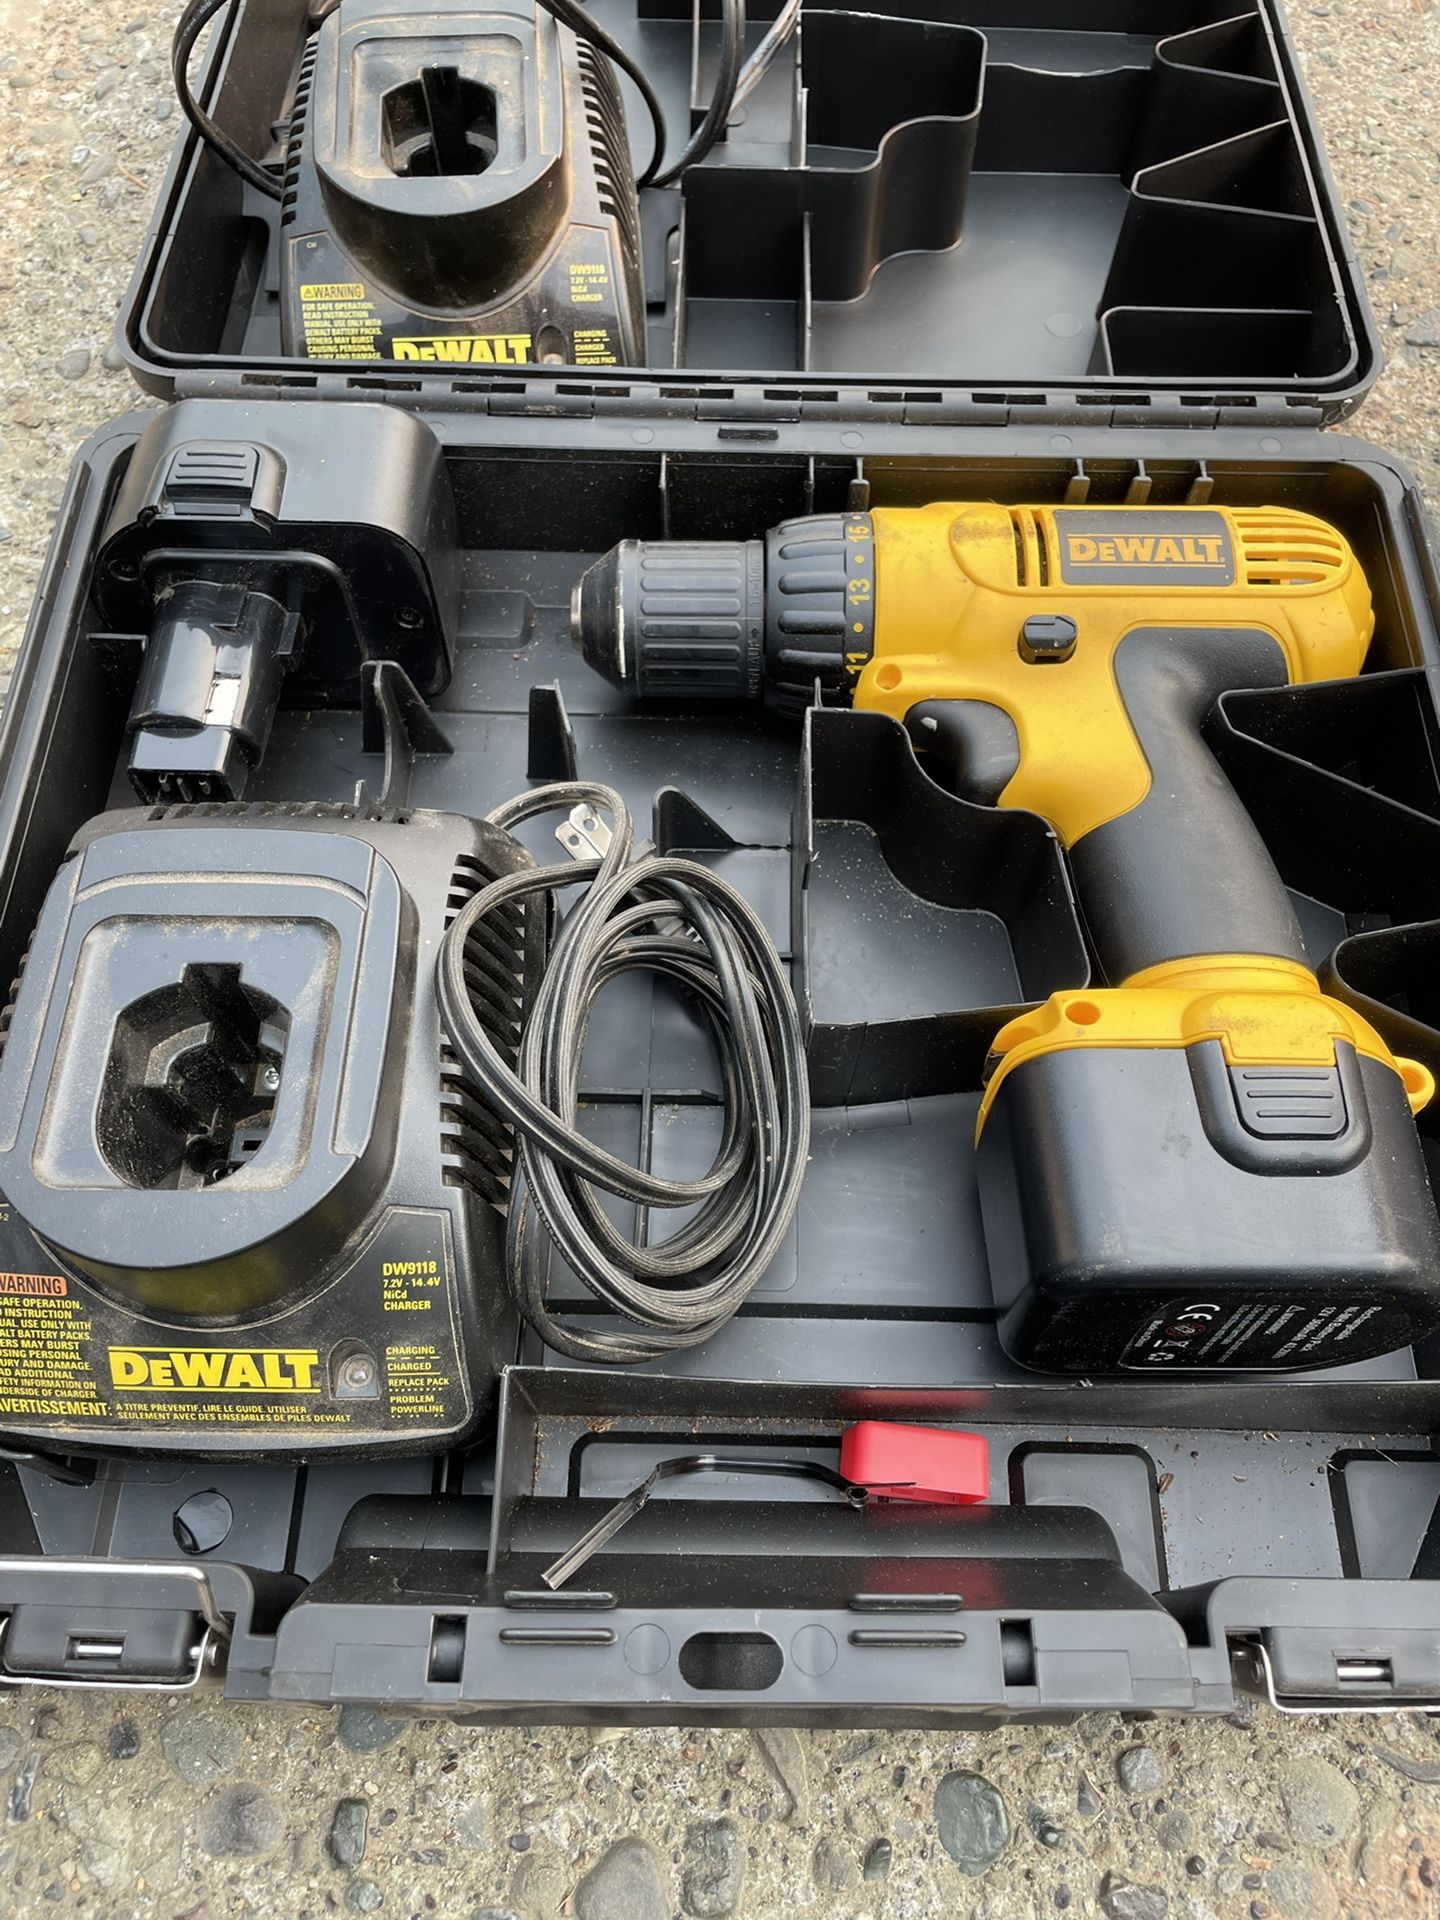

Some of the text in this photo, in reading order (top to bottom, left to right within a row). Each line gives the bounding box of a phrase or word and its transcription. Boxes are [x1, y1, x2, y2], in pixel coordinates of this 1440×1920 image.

[569, 264, 606, 275] DW9118
[313, 285, 361, 299] WARNING
[571, 293, 603, 302] CHARGER
[574, 330, 607, 338] CHARGING
[575, 343, 605, 351] CHARGED
[848, 526, 870, 543] 15
[849, 579, 871, 606] 13
[846, 652, 868, 675] 11
[383, 1261, 437, 1276] DW9118
[383, 1278, 403, 1288] 7.2V
[411, 1276, 441, 1287] 14.4V
[383, 1290, 408, 1299] NiCd
[384, 1300, 432, 1310] CHARGER
[5, 1308, 72, 1319] INSTRUCTION
[0, 1318, 92, 1330] UAL. USE ONLY WITH
[0, 1329, 94, 1341] ALT BATTERY PACKS.
[0, 1339, 80, 1350] ERS MAY BURST
[0, 1349, 82, 1360] SING PERSONAL
[385, 1346, 436, 1355] CHARGING
[0, 1358, 20, 1368] URY
[22, 1359, 44, 1369] AND
[387, 1362, 432, 1371] CHARGED
[0, 1368, 75, 1379] AD ADDITIONAL
[0, 1376, 97, 1389] FETY INFORMATION ON
[388, 1377, 450, 1386] REPLACE PACK
[0, 1386, 40, 1397] DERSIDE
[41, 1388, 53, 1397] OF
[390, 1395, 435, 1404] PROBLEM
[125, 1403, 149, 1412] TITRE
[202, 1404, 221, 1413] LIRE
[224, 1405, 235, 1413] LE
[267, 1406, 307, 1414] UTILISER
[390, 1405, 445, 1414] POWERLINE
[117, 1411, 170, 1420] SEULEMENT
[173, 1412, 197, 1421] AVEC
[198, 1412, 216, 1421] DES
[218, 1413, 273, 1422] ENSEMBLES
[273, 1413, 286, 1422] DE
[287, 1414, 312, 1422] PILES
